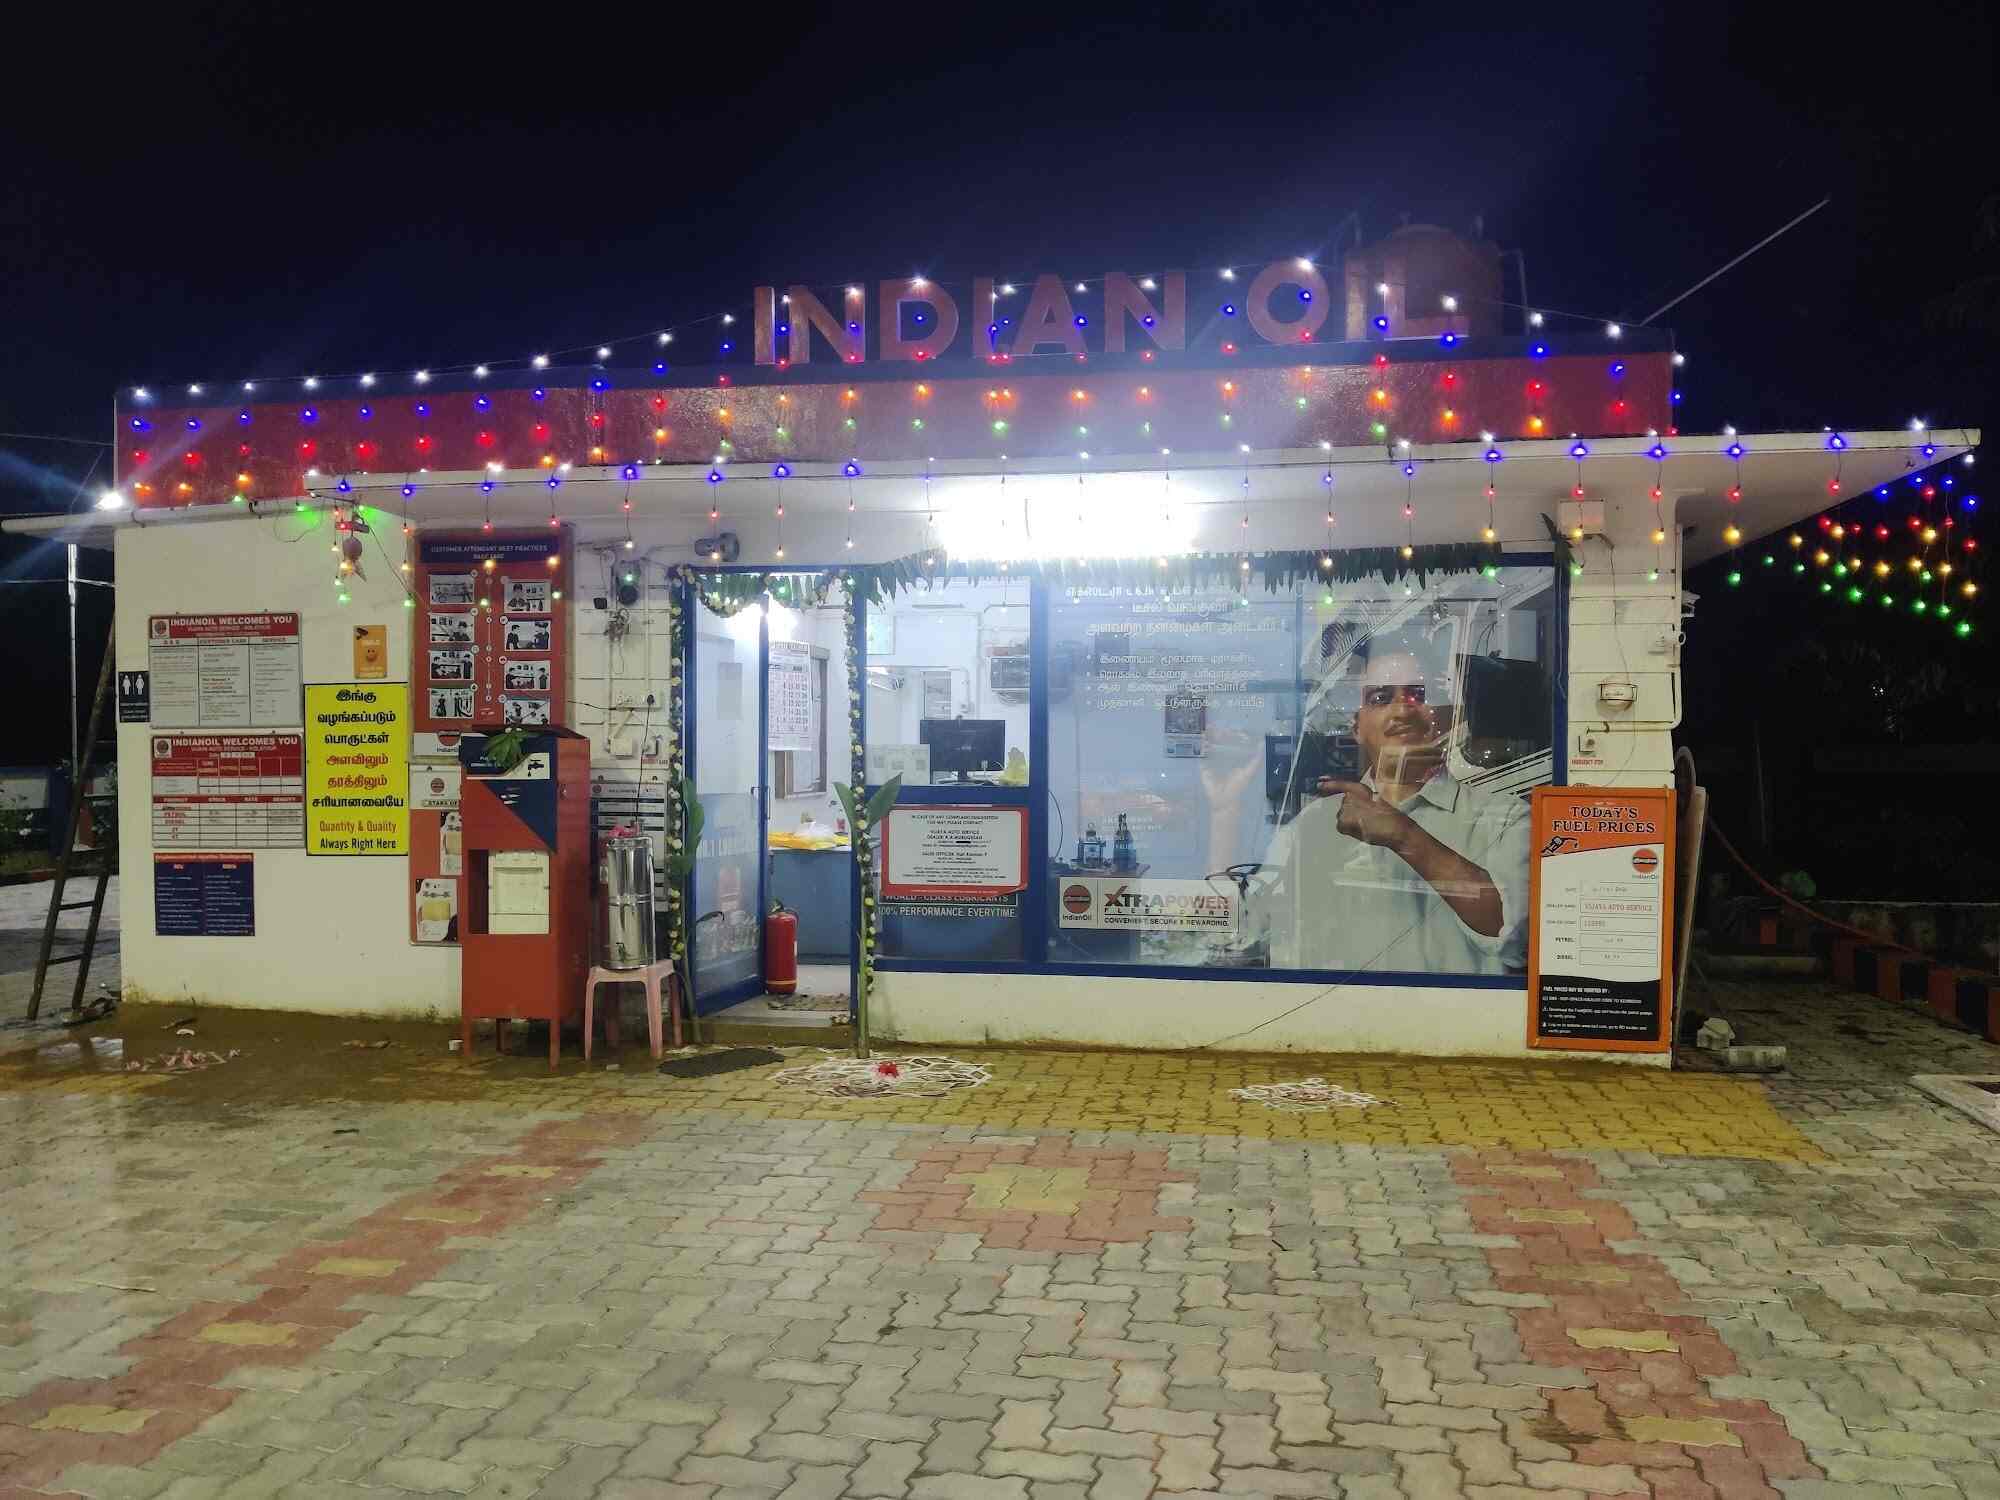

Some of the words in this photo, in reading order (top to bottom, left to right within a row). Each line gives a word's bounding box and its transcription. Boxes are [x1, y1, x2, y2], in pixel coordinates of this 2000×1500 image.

[754, 271, 1187, 365] INDIAN
[1247, 256, 1470, 346] OIL
[170, 618, 216, 626] INDIANOIL
[219, 616, 270, 624] WELCOMES
[273, 615, 292, 624] YOU
[336, 689, 377, 703] இங்கு
[317, 711, 396, 726] வழங்கப்படும்
[173, 738, 220, 746] INDIANOIL
[223, 737, 275, 745] WELCOMES
[278, 737, 298, 745] YOU
[324, 732, 390, 746] பொருட்கள்
[326, 753, 389, 768] அளவிலும்
[328, 774, 388, 790] தரத்திலும்
[312, 795, 404, 808] சரியானவையே
[1570, 806, 1639, 818] TODAY'S
[319, 821, 355, 834] Quantity
[357, 821, 364, 832] &
[366, 821, 397, 834] Quality
[1552, 820, 1593, 832] FUEL
[1598, 821, 1656, 833] PRICES
[320, 838, 349, 850] Always
[351, 838, 374, 851] Right
[376, 838, 397, 849] Here
[1104, 886, 1229, 909] XTRAPOWER
[900, 907, 962, 917] PERFORMANCE
[968, 908, 1016, 917] EVERYTIME
